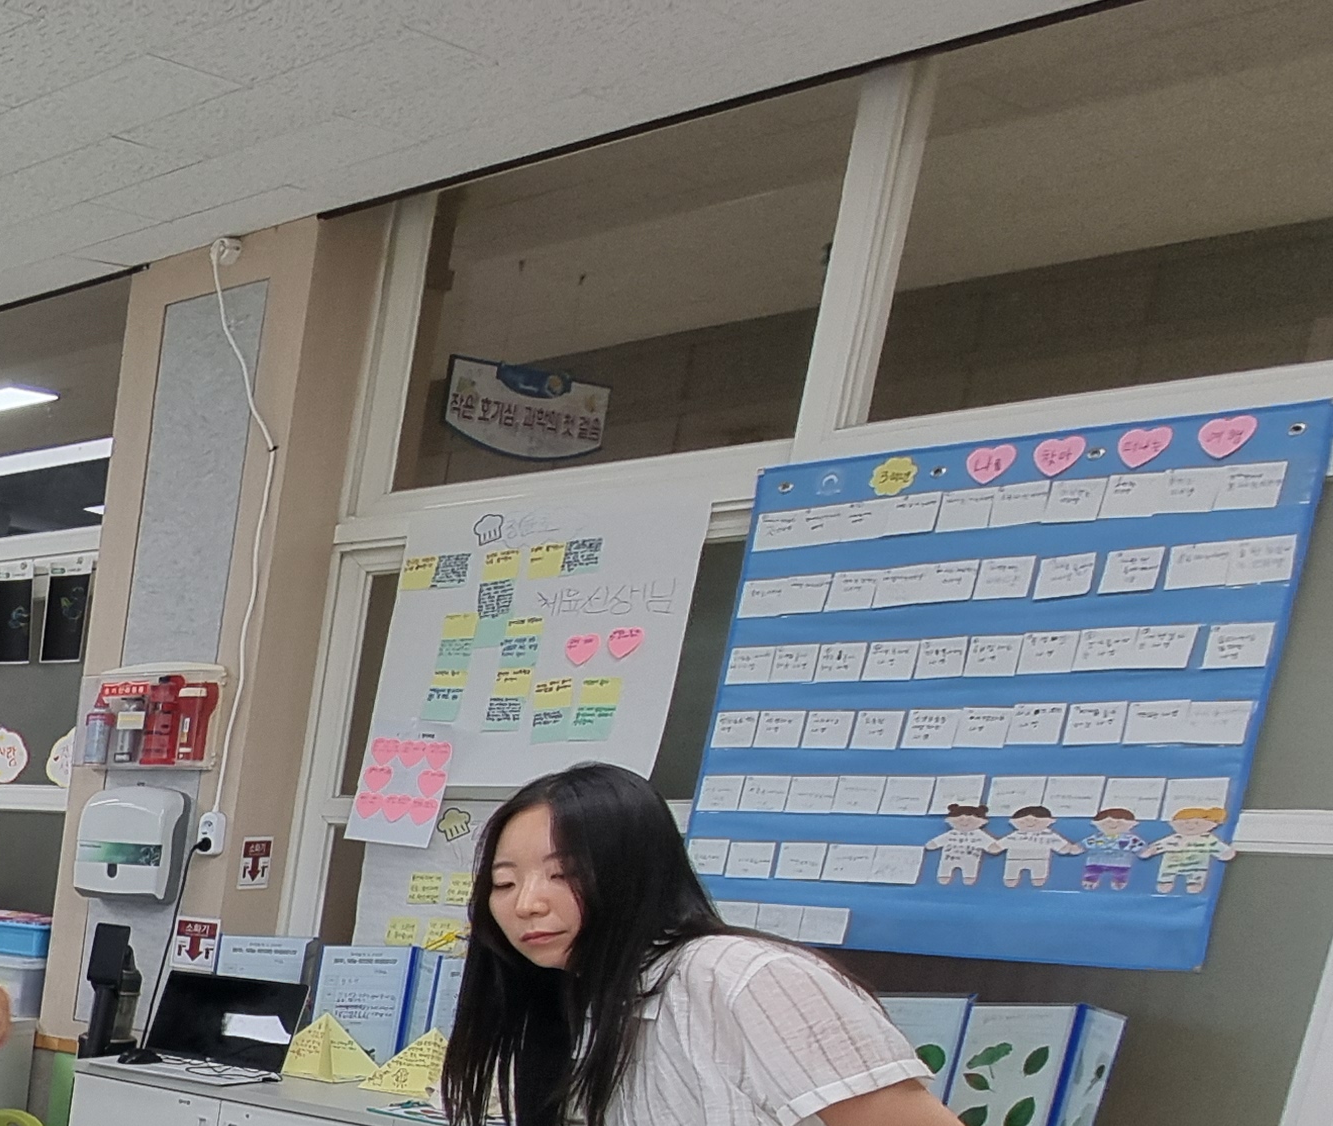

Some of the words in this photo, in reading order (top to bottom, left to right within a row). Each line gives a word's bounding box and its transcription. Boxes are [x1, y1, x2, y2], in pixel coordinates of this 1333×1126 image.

[451, 393, 475, 420] 작은
[523, 406, 560, 432] 과학의
[562, 413, 575, 437] 첫
[578, 416, 602, 442] 걸음
[248, 843, 267, 853] 소화기
[186, 923, 210, 935] 소화기
